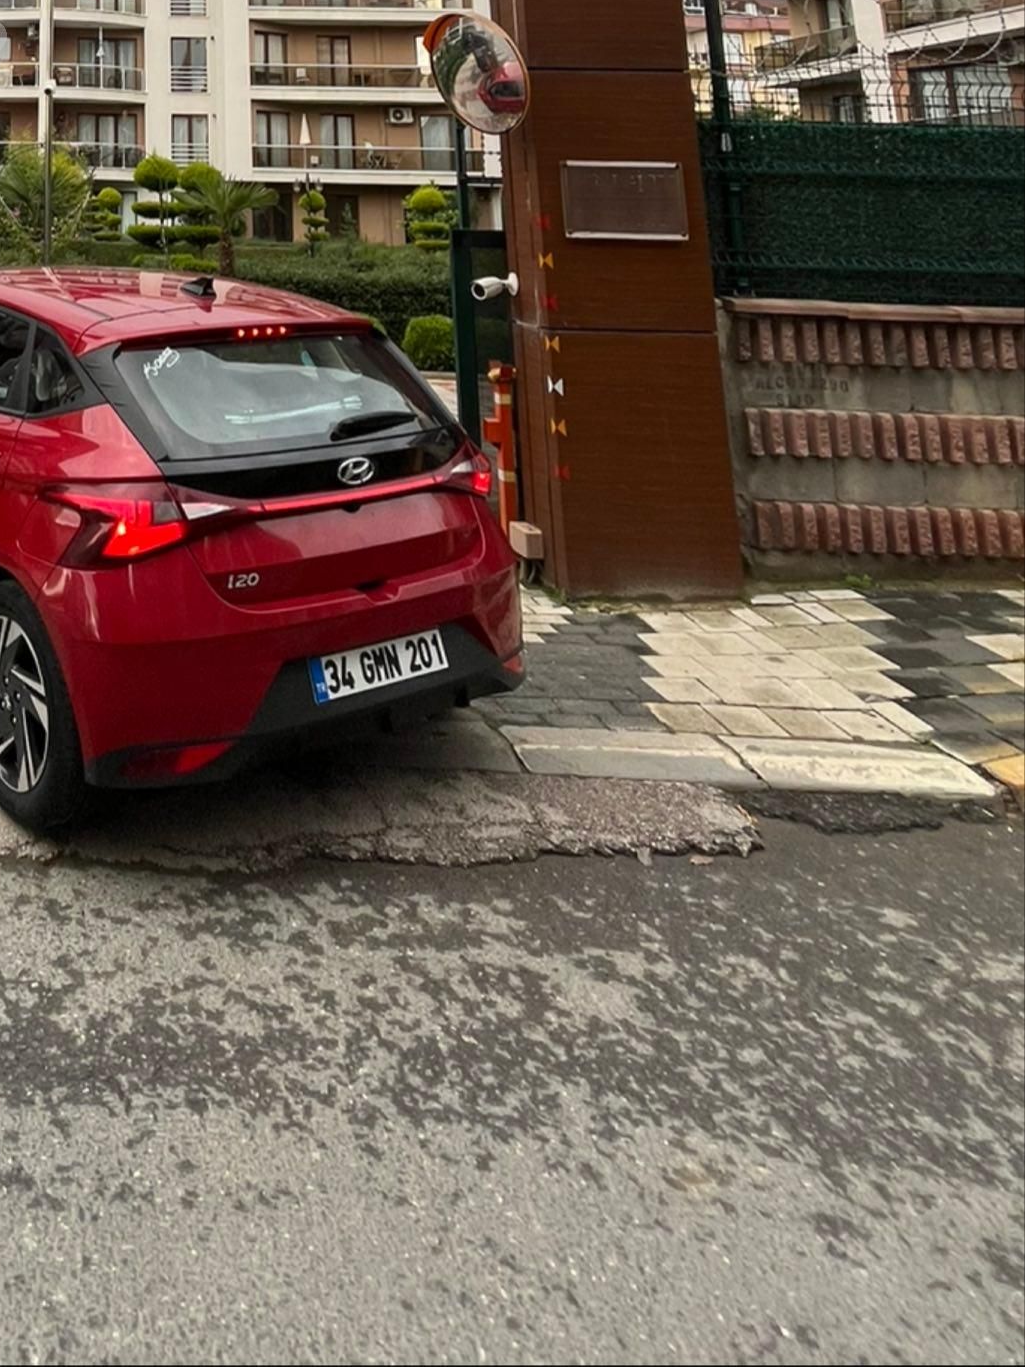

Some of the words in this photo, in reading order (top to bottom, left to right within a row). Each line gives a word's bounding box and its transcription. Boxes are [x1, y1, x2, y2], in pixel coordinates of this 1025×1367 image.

[325, 656, 355, 694] 34
[359, 644, 402, 684] GMN
[405, 633, 443, 673] 201
